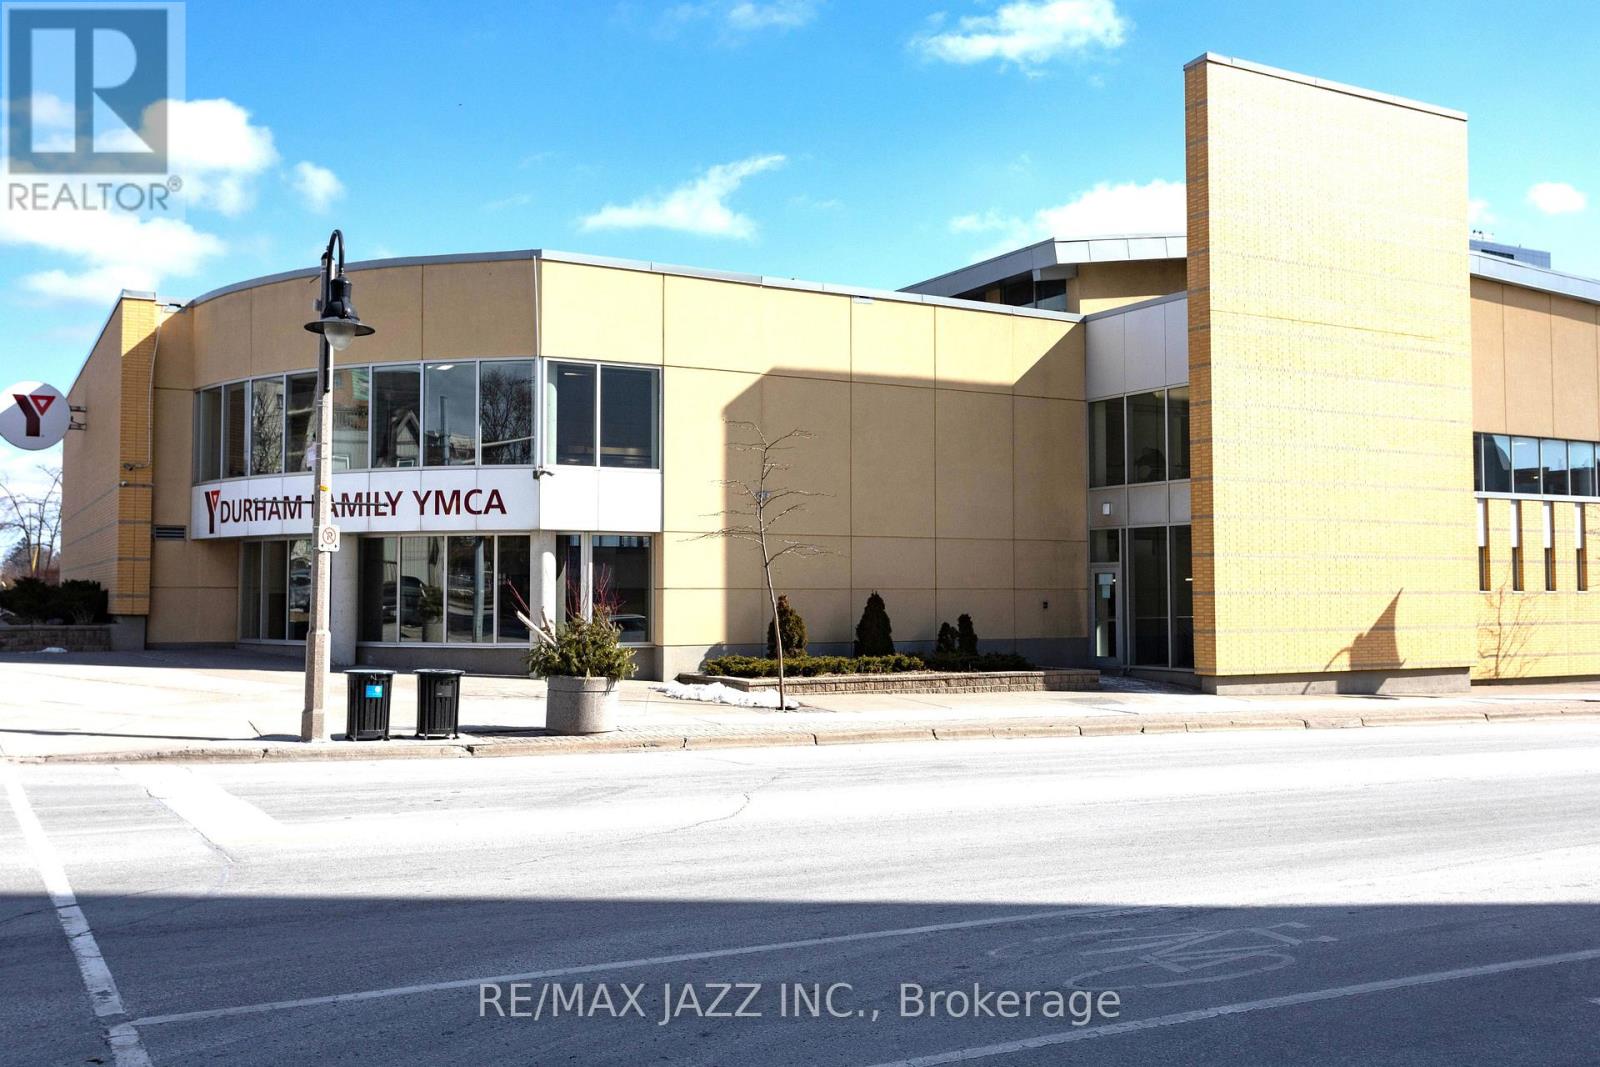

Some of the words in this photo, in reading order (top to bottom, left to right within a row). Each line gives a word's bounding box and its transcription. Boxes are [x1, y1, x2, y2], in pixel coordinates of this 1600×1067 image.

[221, 495, 302, 524] DURHAM
[312, 491, 403, 518] MILY
[412, 489, 507, 516] YMCA
